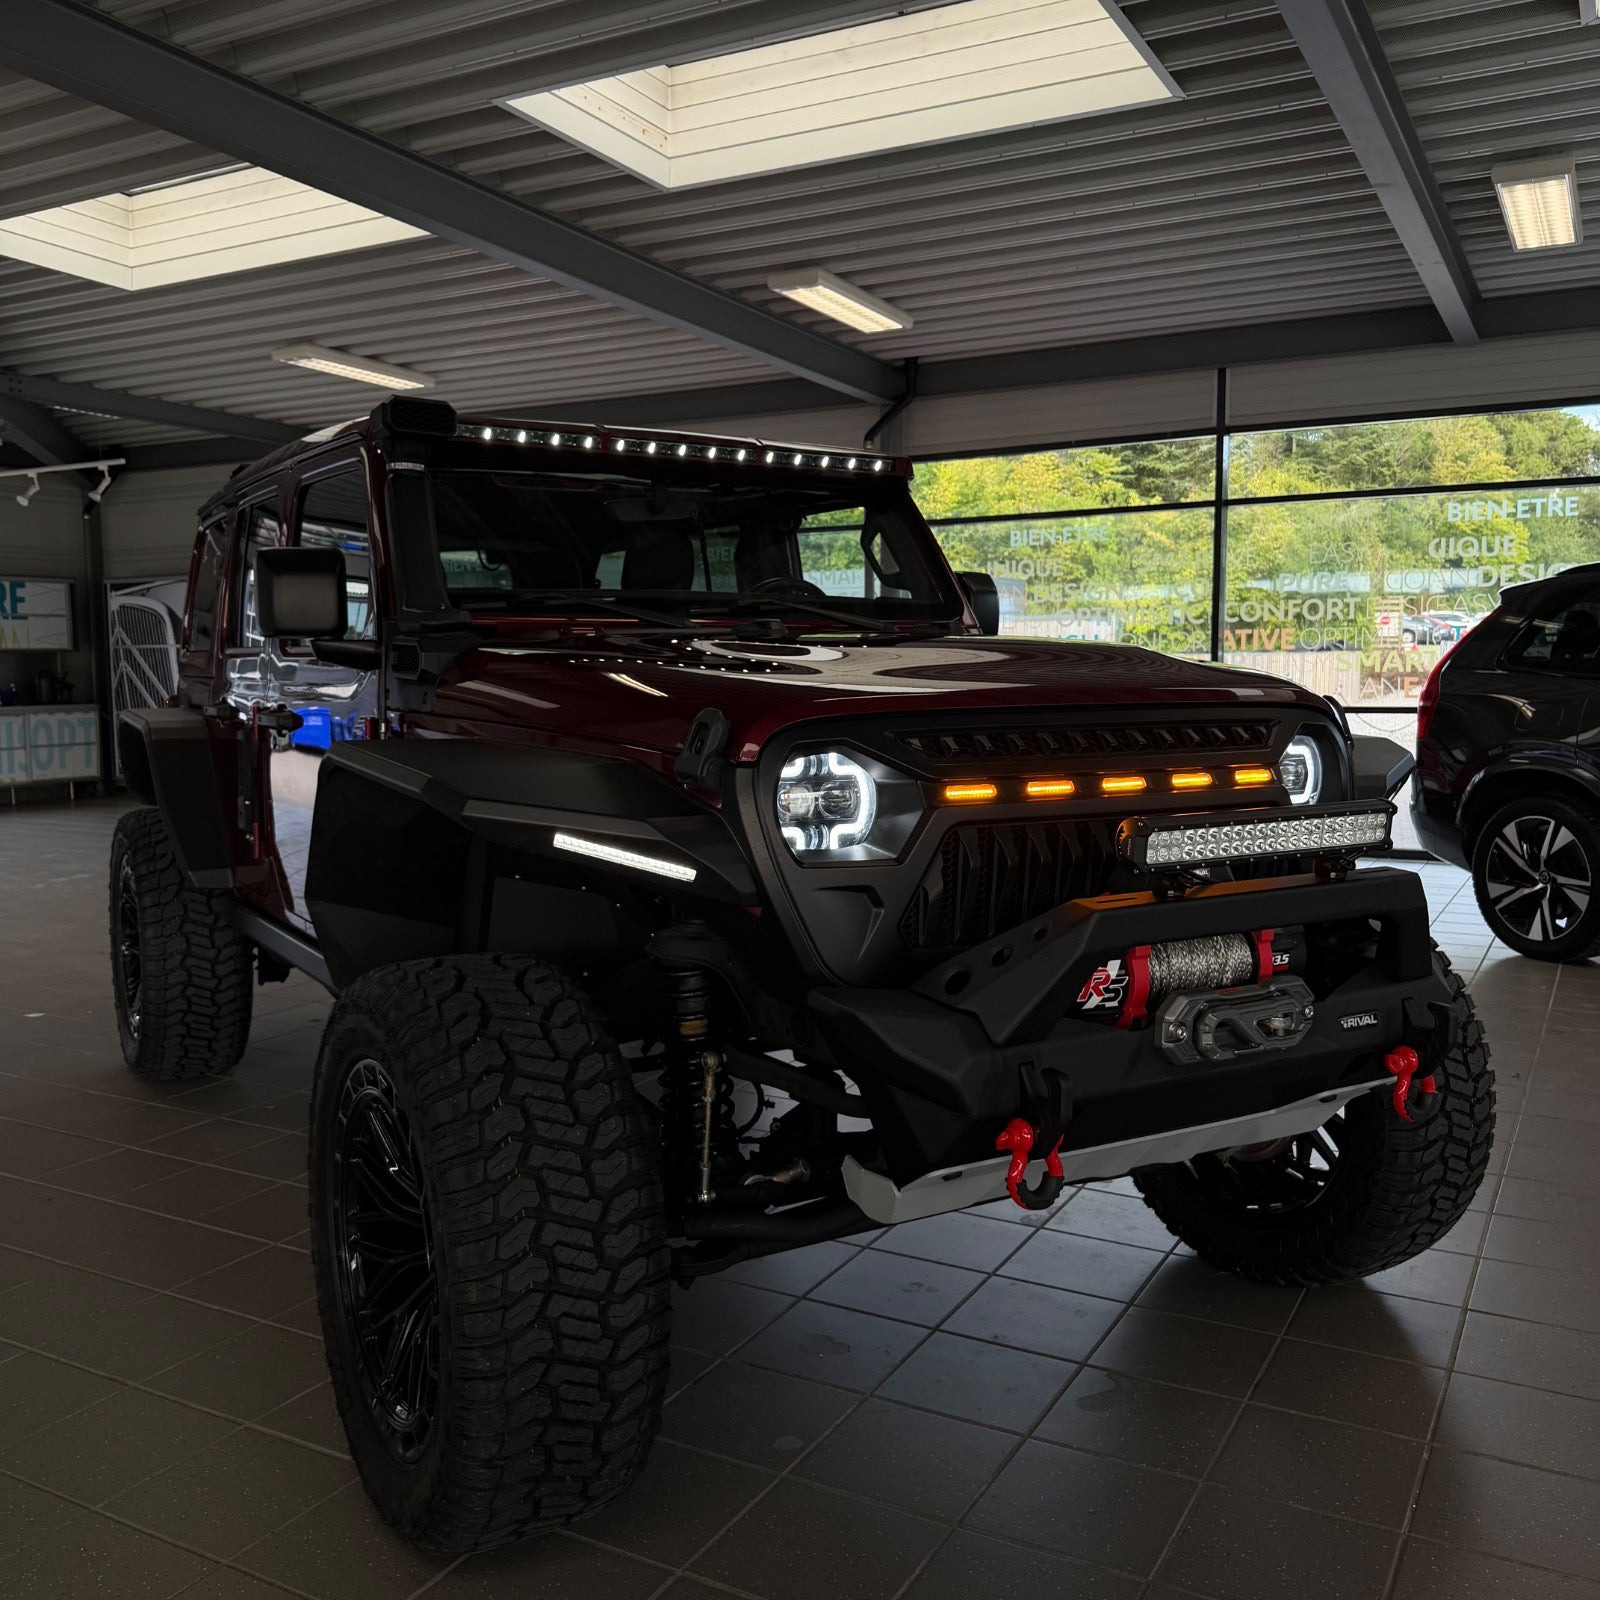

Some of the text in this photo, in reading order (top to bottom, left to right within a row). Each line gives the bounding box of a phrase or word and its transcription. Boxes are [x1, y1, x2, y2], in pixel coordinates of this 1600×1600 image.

[1447, 496, 1580, 522] BIEN-ETRE
[1010, 525, 1109, 548] BIEN-ETRE
[1276, 570, 1350, 594] PURE
[1225, 598, 1361, 623] CONFORT
[1347, 1015, 1378, 1028] RIVAL
